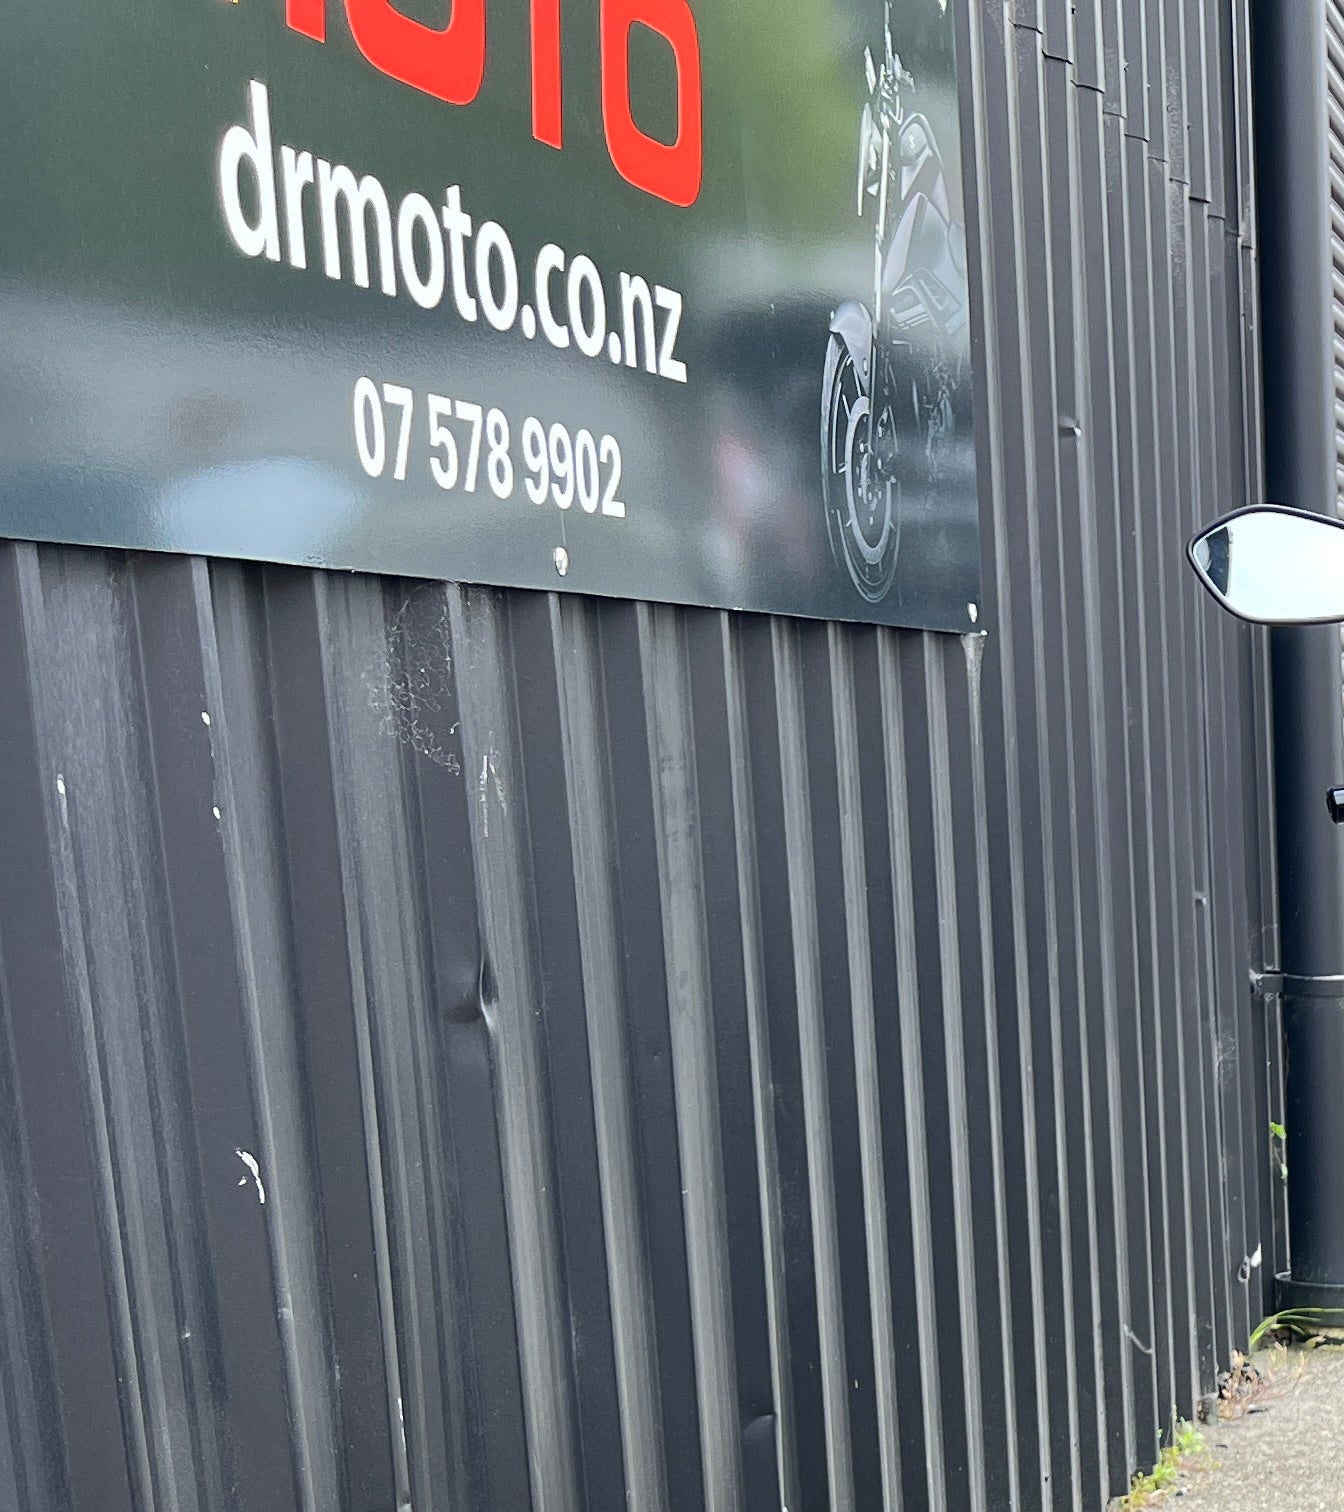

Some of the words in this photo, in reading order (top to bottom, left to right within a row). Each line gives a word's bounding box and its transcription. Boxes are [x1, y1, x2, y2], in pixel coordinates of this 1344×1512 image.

[219, 79, 688, 383] drmoto.co.nz
[353, 377, 413, 481] 07
[427, 394, 515, 500] 578
[522, 416, 627, 518] 9902
